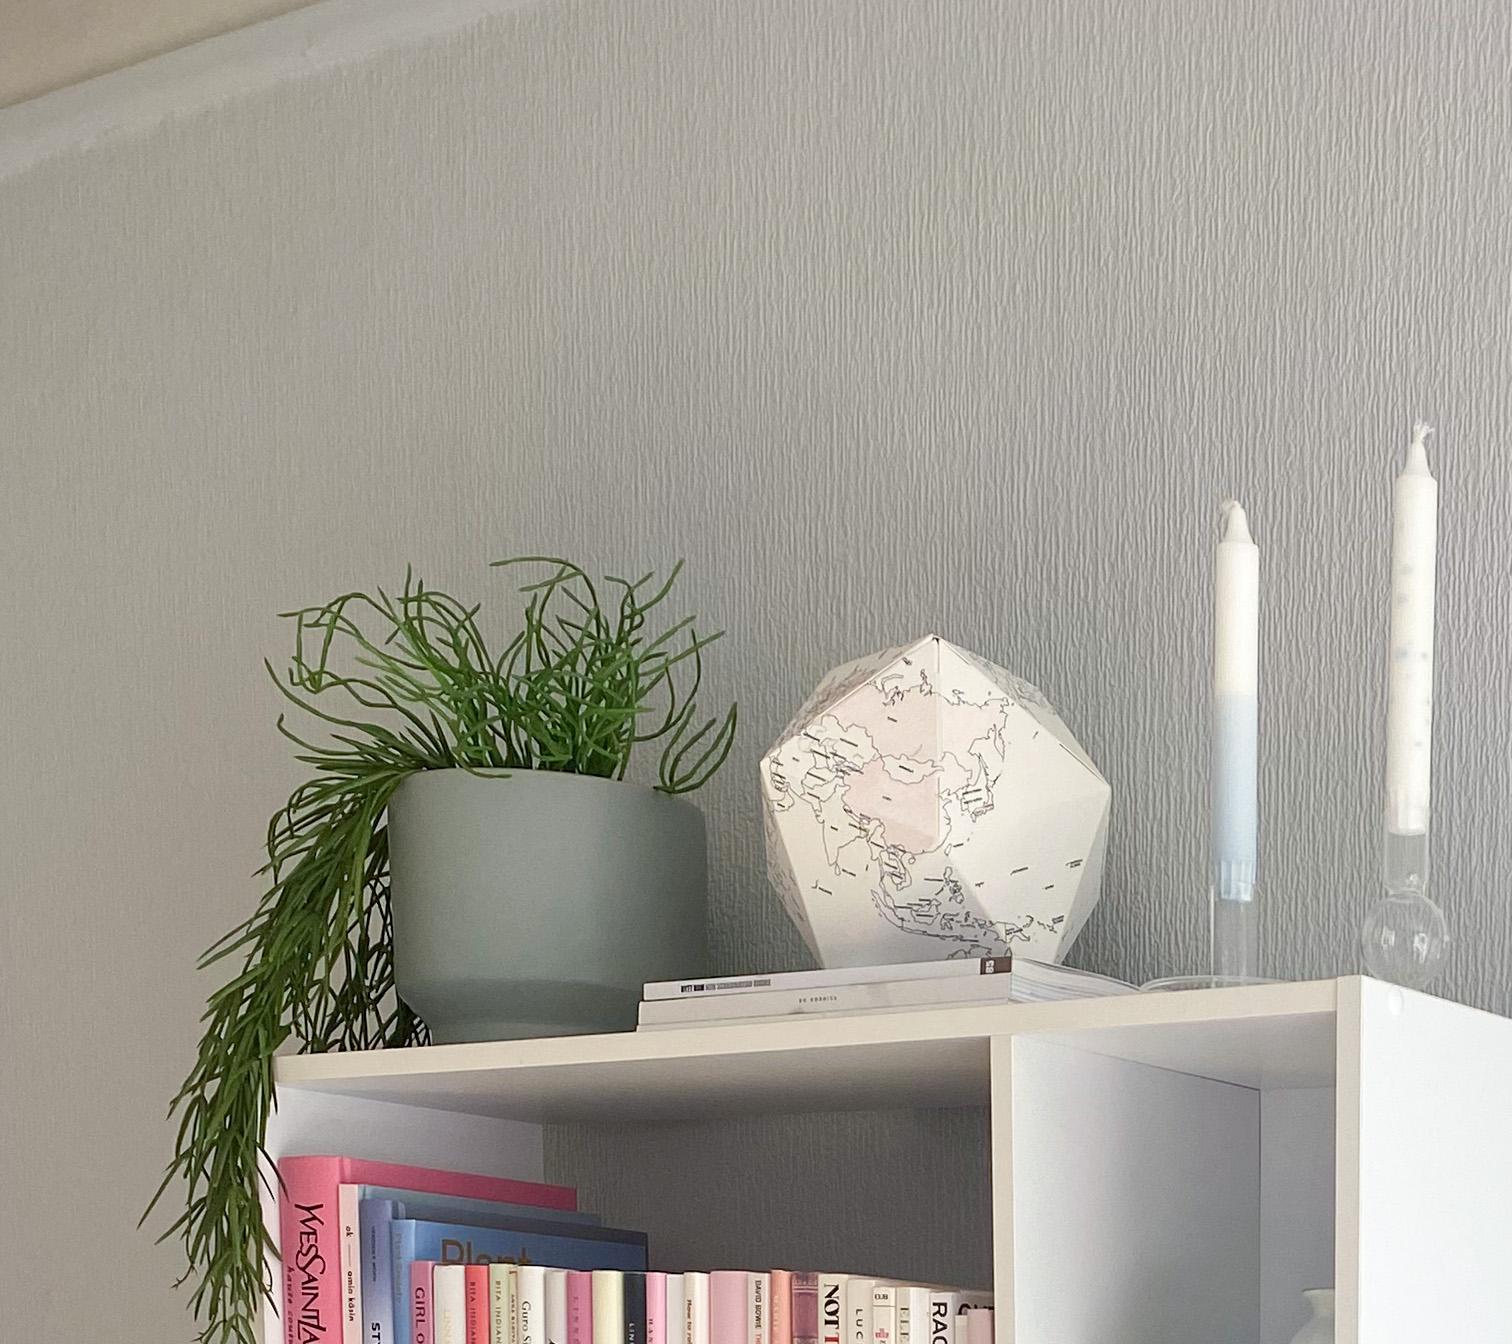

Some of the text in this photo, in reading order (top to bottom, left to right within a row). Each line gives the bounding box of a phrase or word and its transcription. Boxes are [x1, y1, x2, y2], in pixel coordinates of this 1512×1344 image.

[469, 1280, 477, 1303] RITA
[495, 1280, 503, 1301] RITA
[755, 1279, 763, 1303] DAVID
[415, 1287, 426, 1329] GIRL
[521, 1301, 532, 1331] Guro
[755, 1304, 763, 1329] BOWIE
[824, 1284, 840, 1330] NOT
[687, 1321, 693, 1331] to
